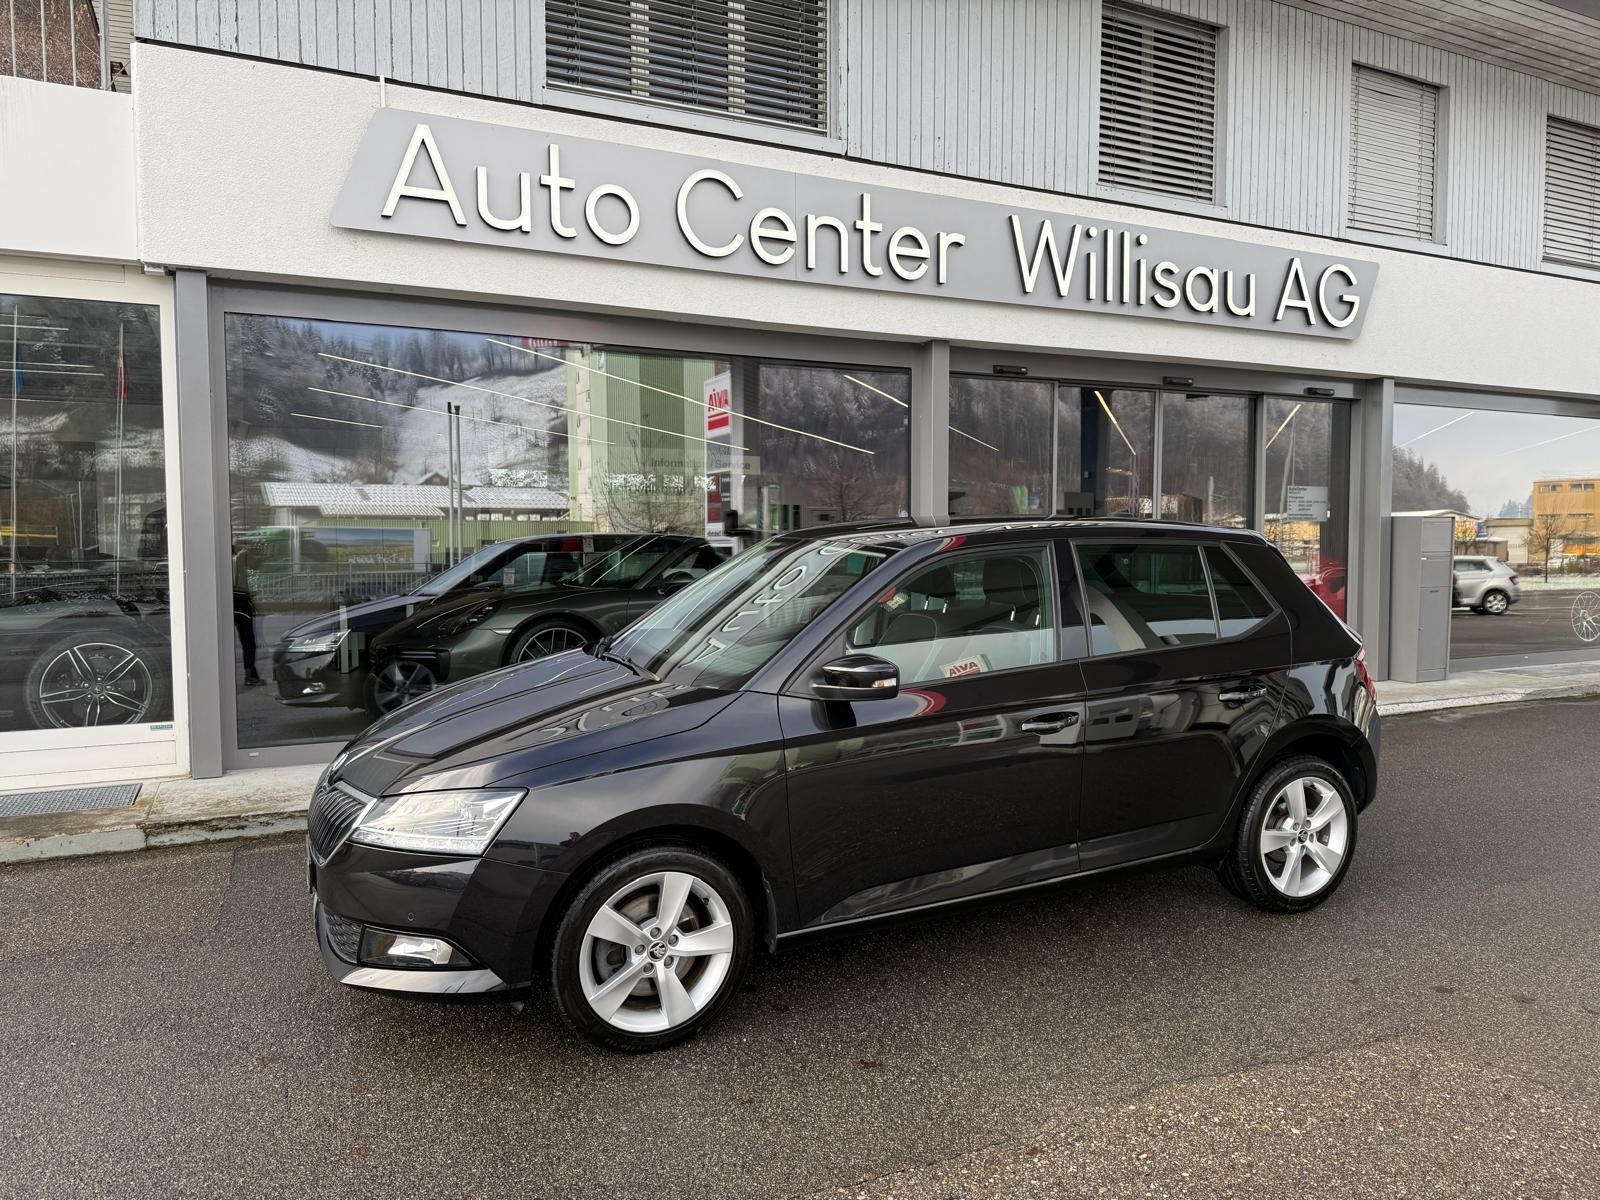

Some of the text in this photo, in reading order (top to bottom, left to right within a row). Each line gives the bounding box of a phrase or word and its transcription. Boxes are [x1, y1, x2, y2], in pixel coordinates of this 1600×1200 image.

[381, 123, 1361, 328] Auto Center Willisau AG
